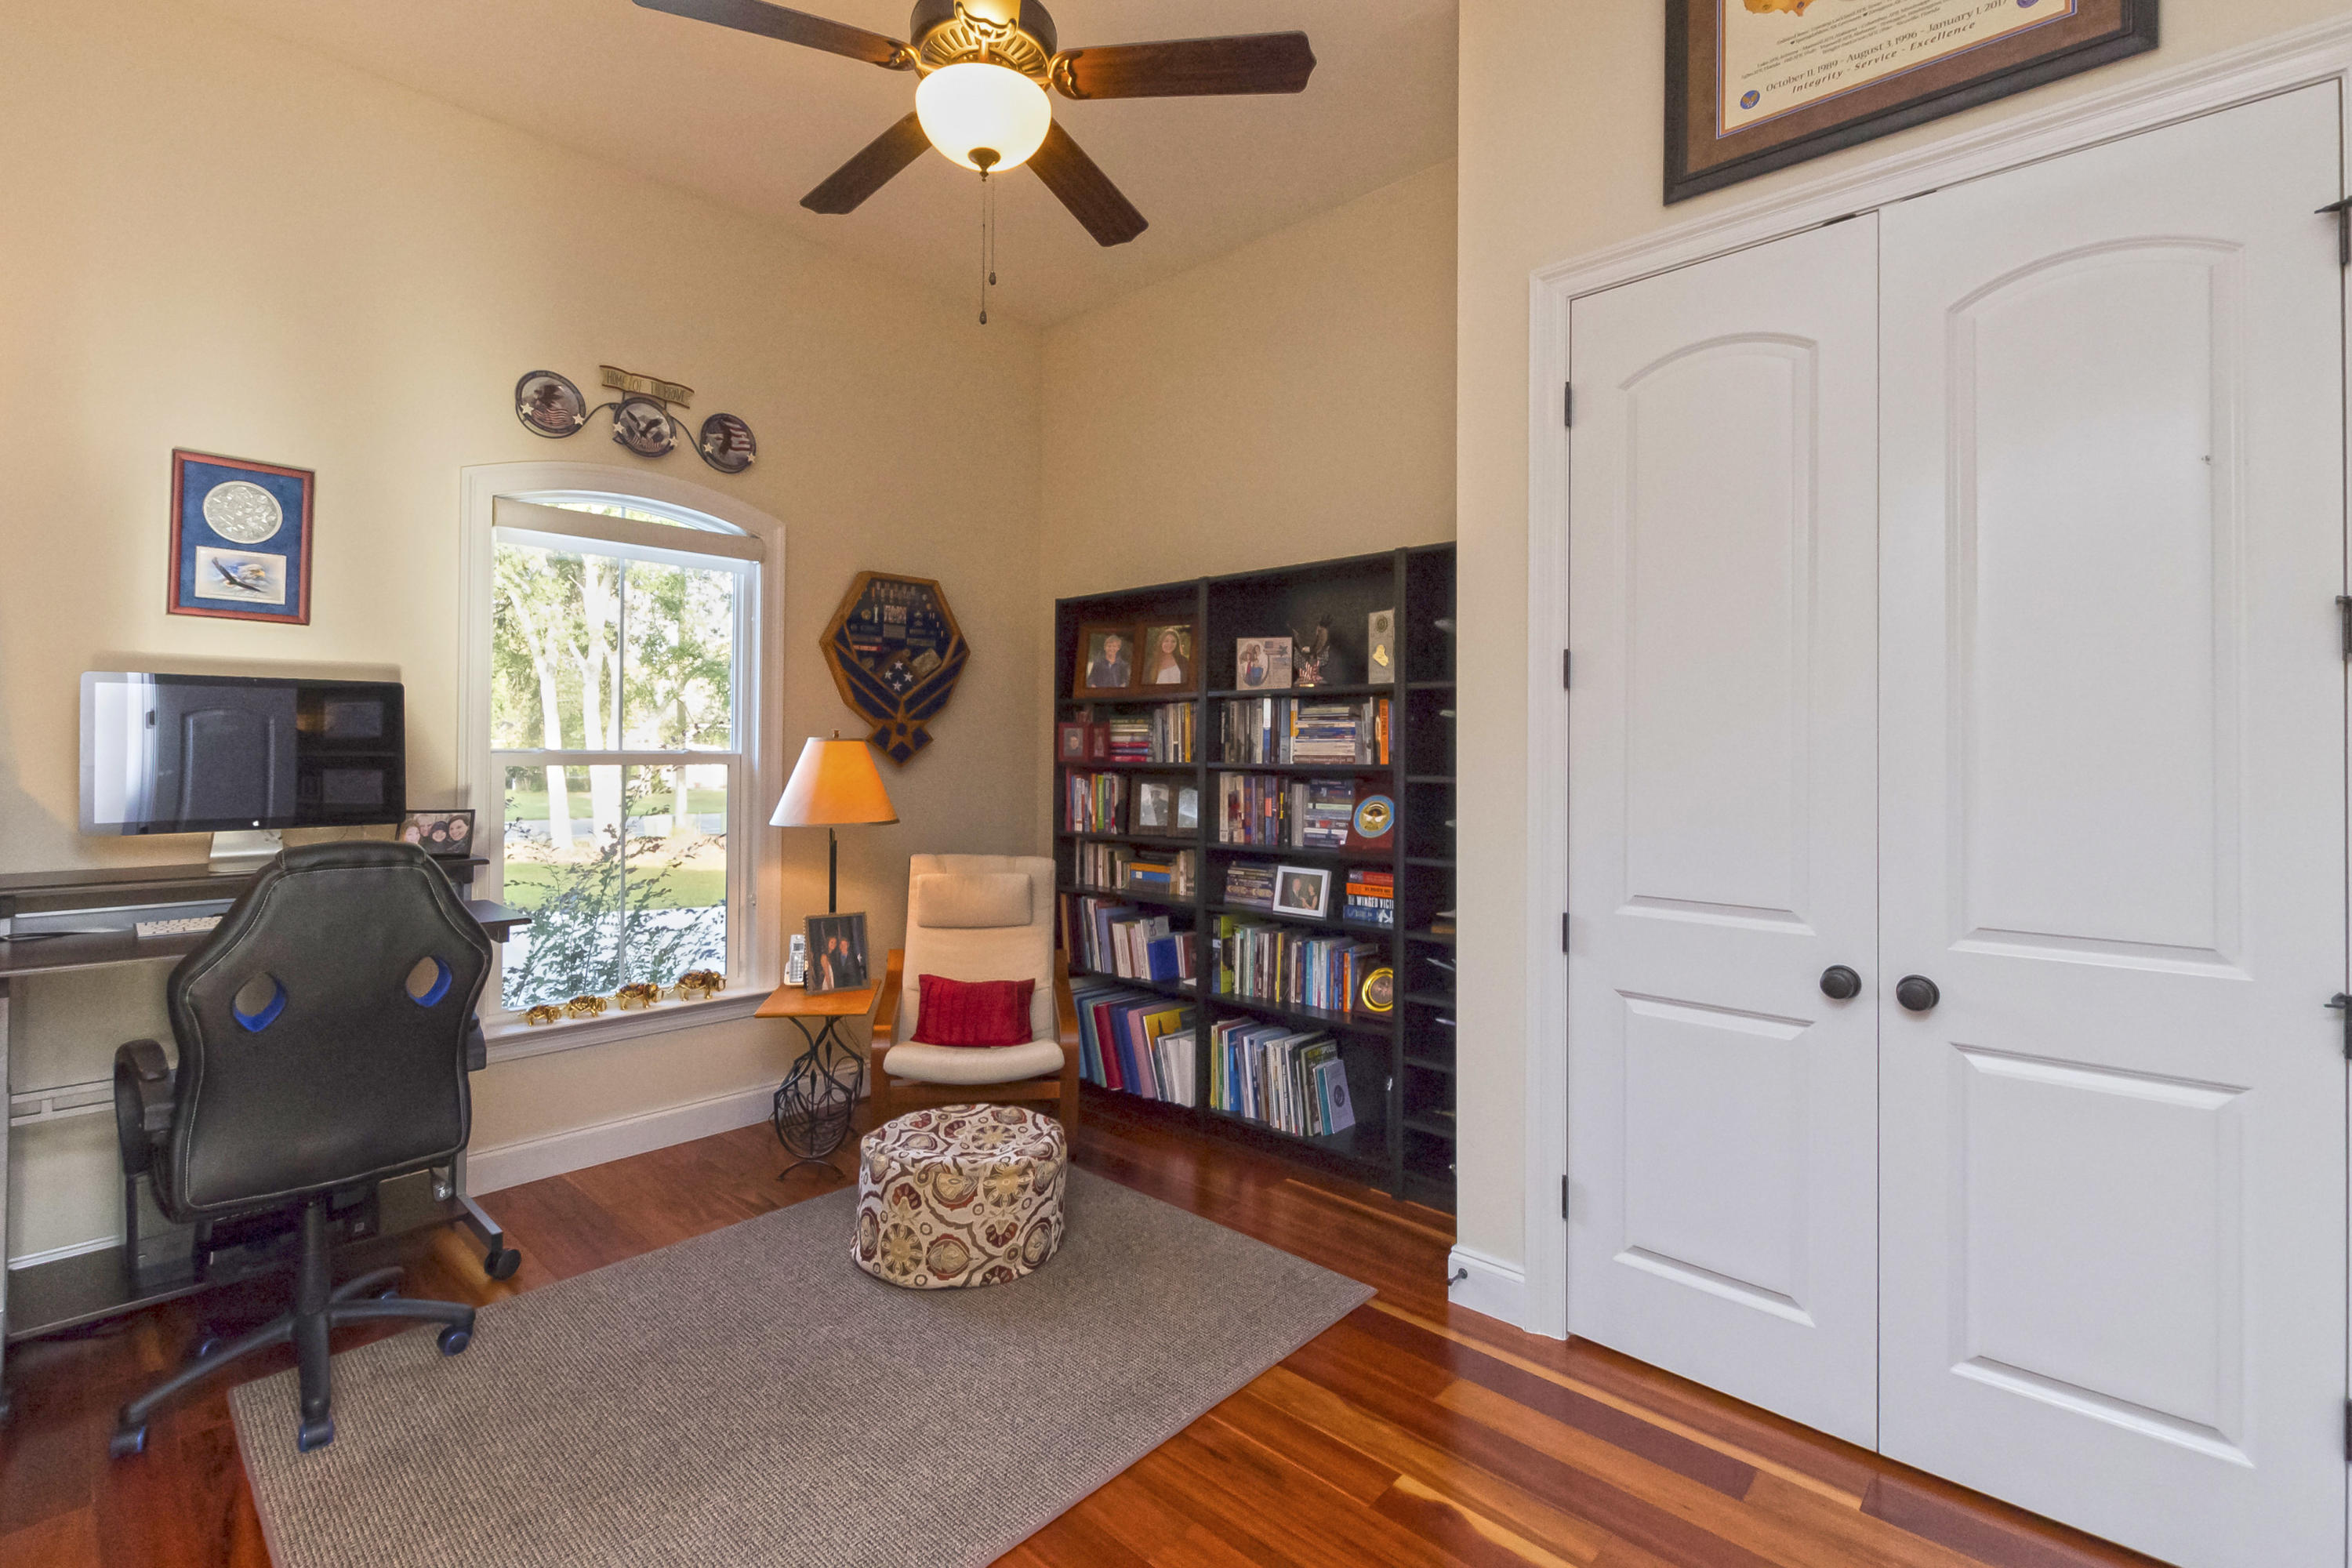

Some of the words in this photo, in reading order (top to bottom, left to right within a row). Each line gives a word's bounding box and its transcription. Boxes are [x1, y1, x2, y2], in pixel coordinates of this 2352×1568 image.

[1766, 74, 1805, 92] October
[1817, 60, 1838, 74] 1989
[1846, 42, 1883, 63] August
[1895, 32, 1918, 45] 1996
[1929, 9, 1974, 32] January
[1792, 71, 1842, 93] Integrity
[1854, 50, 1897, 71] Service
[1910, 21, 1976, 51] Excellence
[607, 370, 625, 386] HOME
